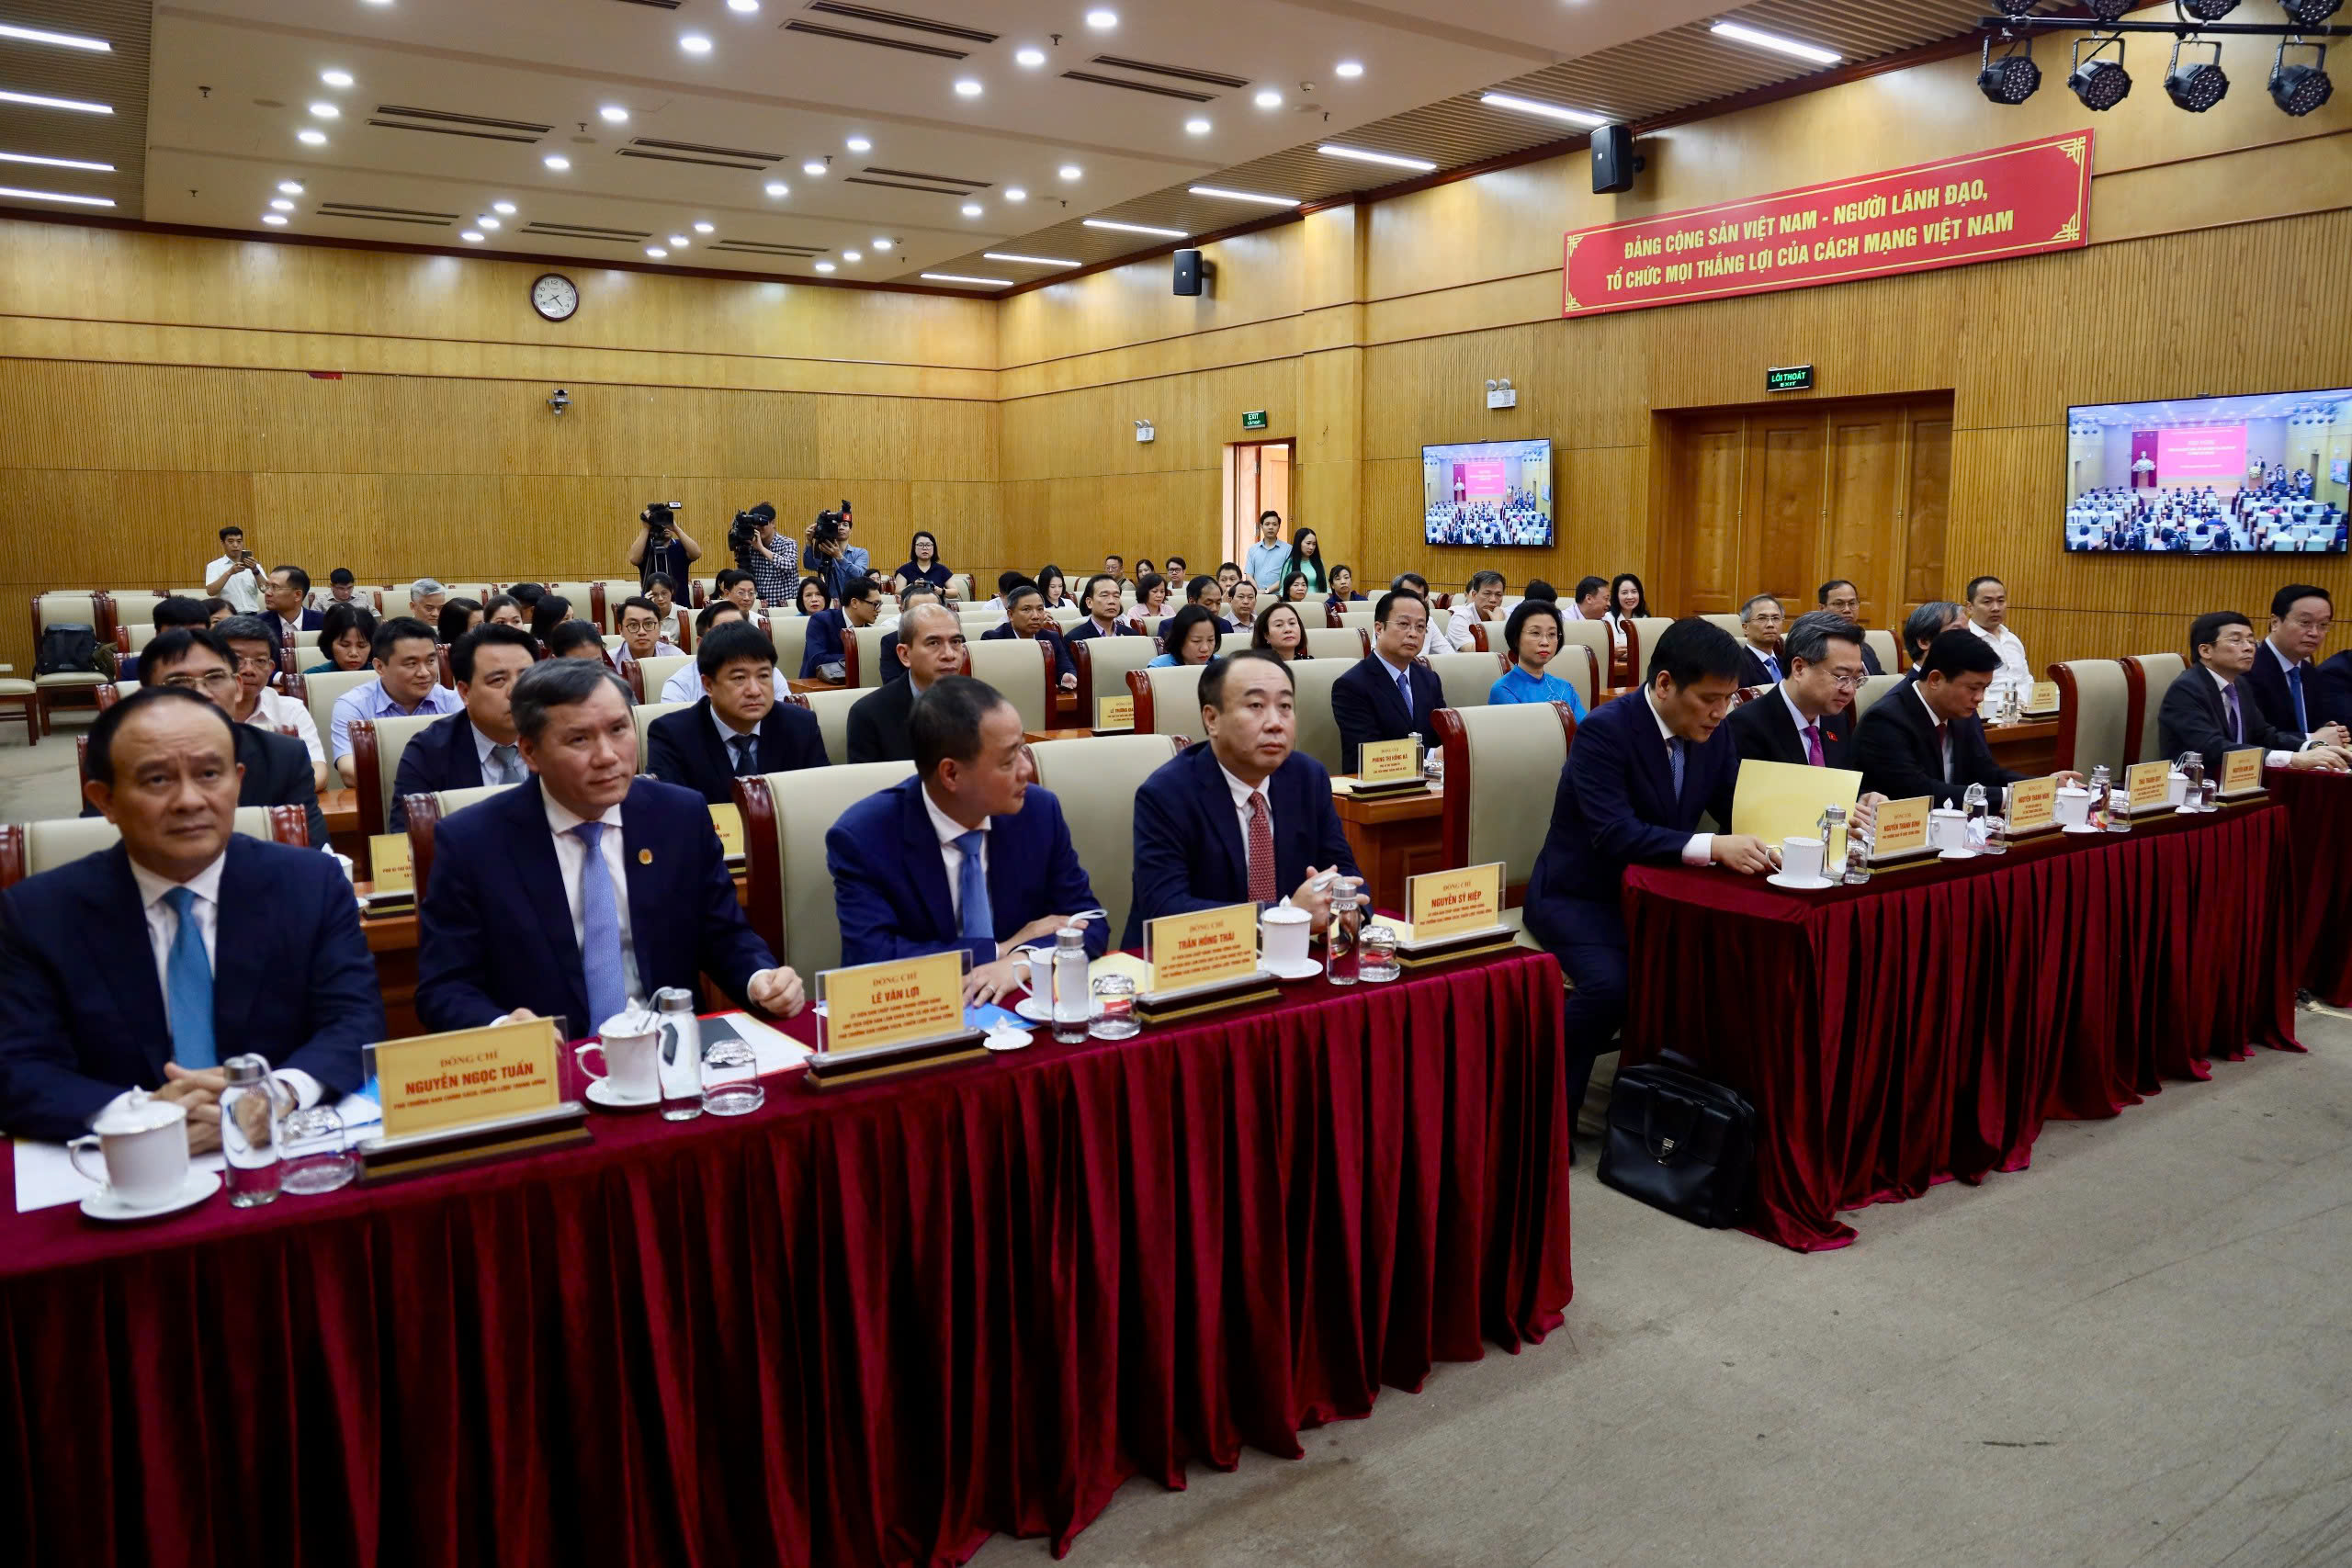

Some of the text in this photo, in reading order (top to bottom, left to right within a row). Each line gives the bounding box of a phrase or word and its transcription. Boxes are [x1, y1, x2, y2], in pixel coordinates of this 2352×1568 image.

[1624, 234, 1662, 259] ĐẢNG
[1666, 230, 1704, 254] CỘNG
[1708, 220, 1739, 246] SẢN
[1743, 215, 1776, 242] VIỆT
[1779, 209, 1817, 234] NAM
[1833, 194, 1887, 226] NGƯỜI
[1892, 188, 1940, 215] LÃNH
[1944, 178, 1988, 208] ĐẠO,
[1606, 209, 2015, 292] TỔ CHỨC MỌI THẮNG LỢI CỦA CÁCH MẠNG VIỆT NAM
[1771, 370, 1806, 383] LỐI THOÁT
[1431, 893, 1457, 908] NGUYỄN
[872, 986, 920, 1005] LÊ VĂN LỢI
[440, 1049, 499, 1068] ĐỒNG CHÍ
[405, 1059, 534, 1095] NGUYỄN NGỌC TUẤN
